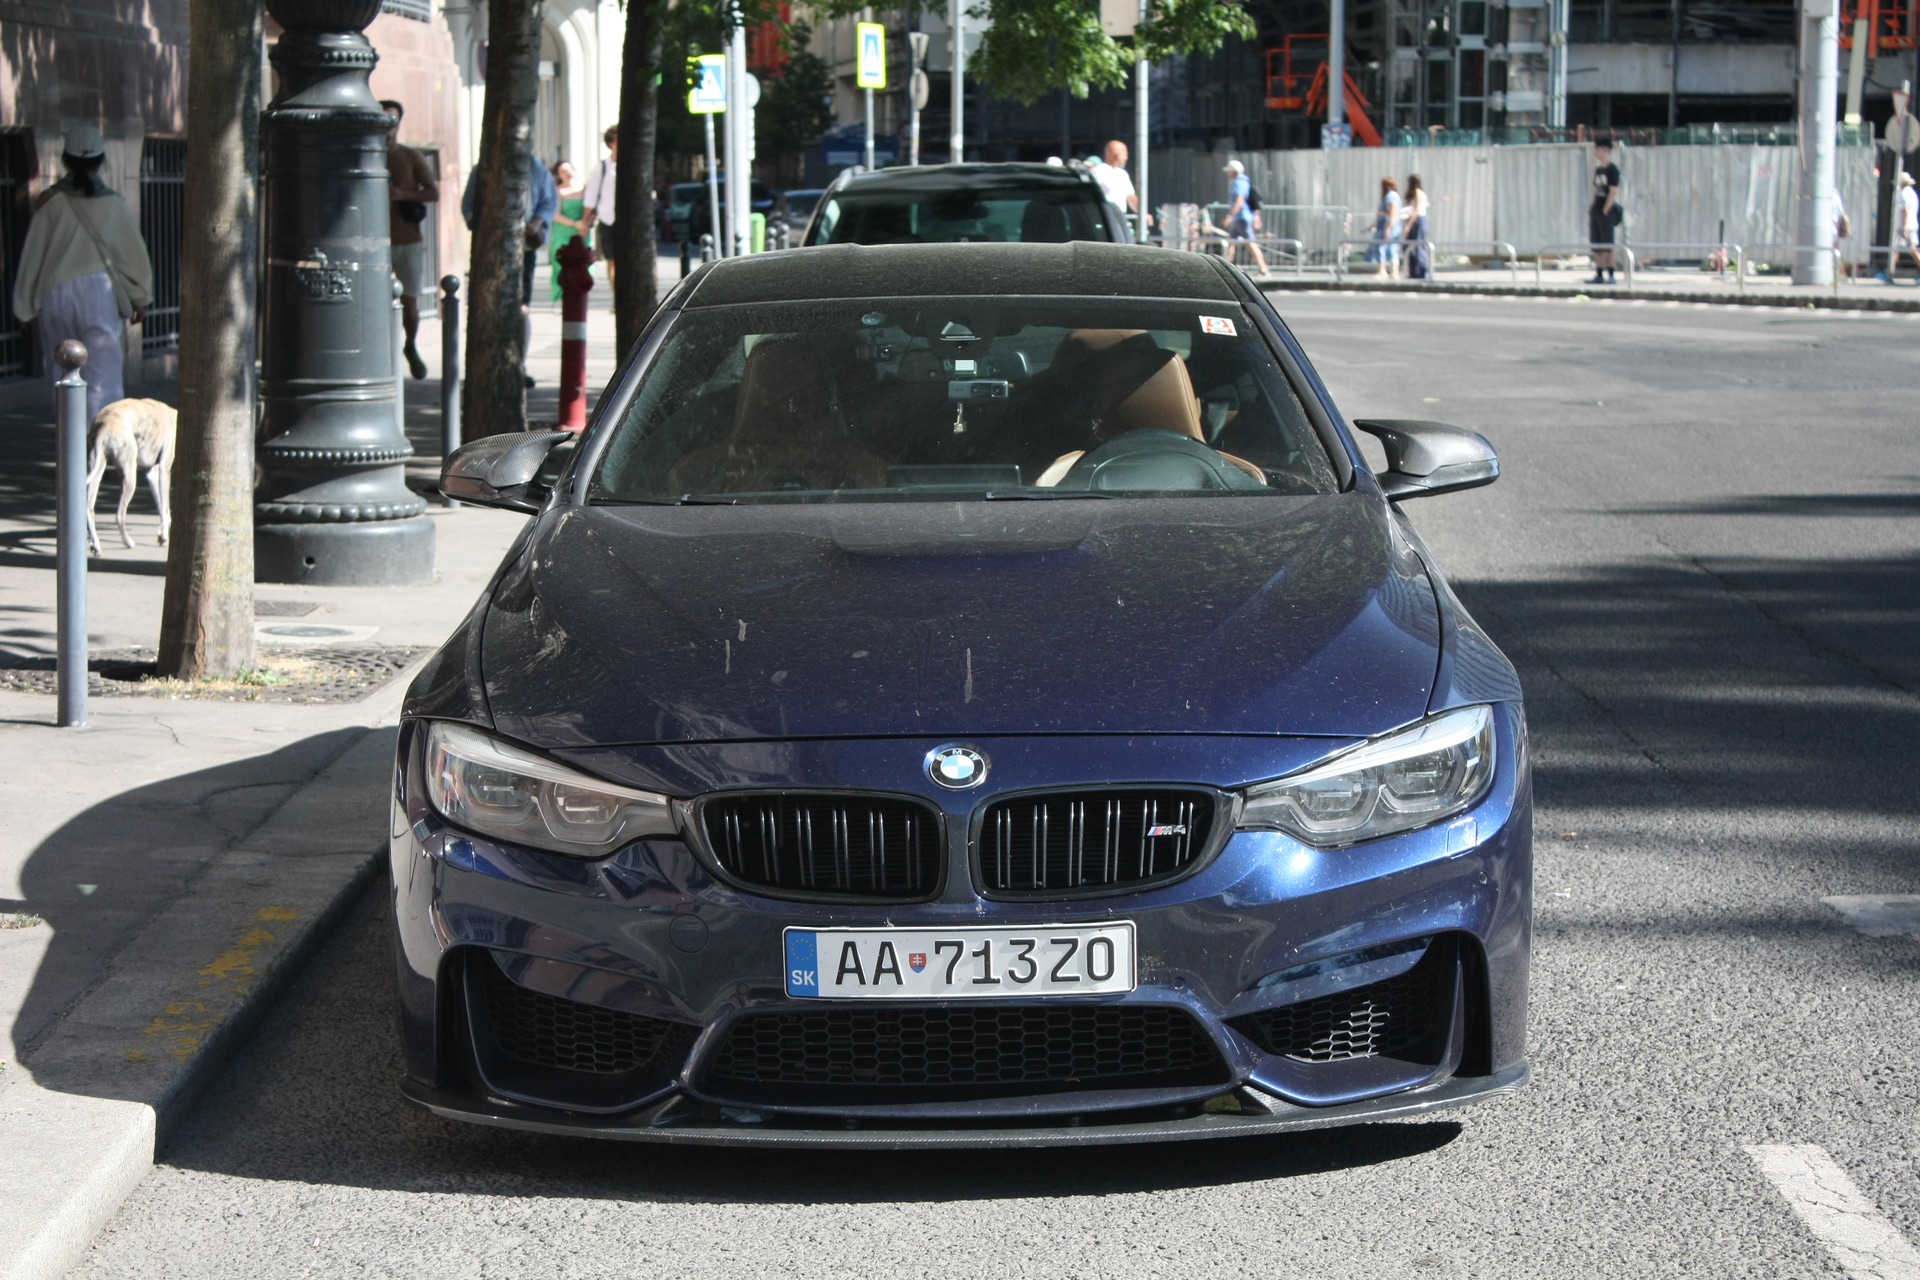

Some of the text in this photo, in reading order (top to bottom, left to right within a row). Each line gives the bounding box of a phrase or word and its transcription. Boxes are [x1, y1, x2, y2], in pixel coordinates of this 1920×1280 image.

[935, 749, 981, 761] BMW
[1159, 824, 1186, 836] M4
[835, 941, 904, 985] AA
[792, 970, 816, 986] SK
